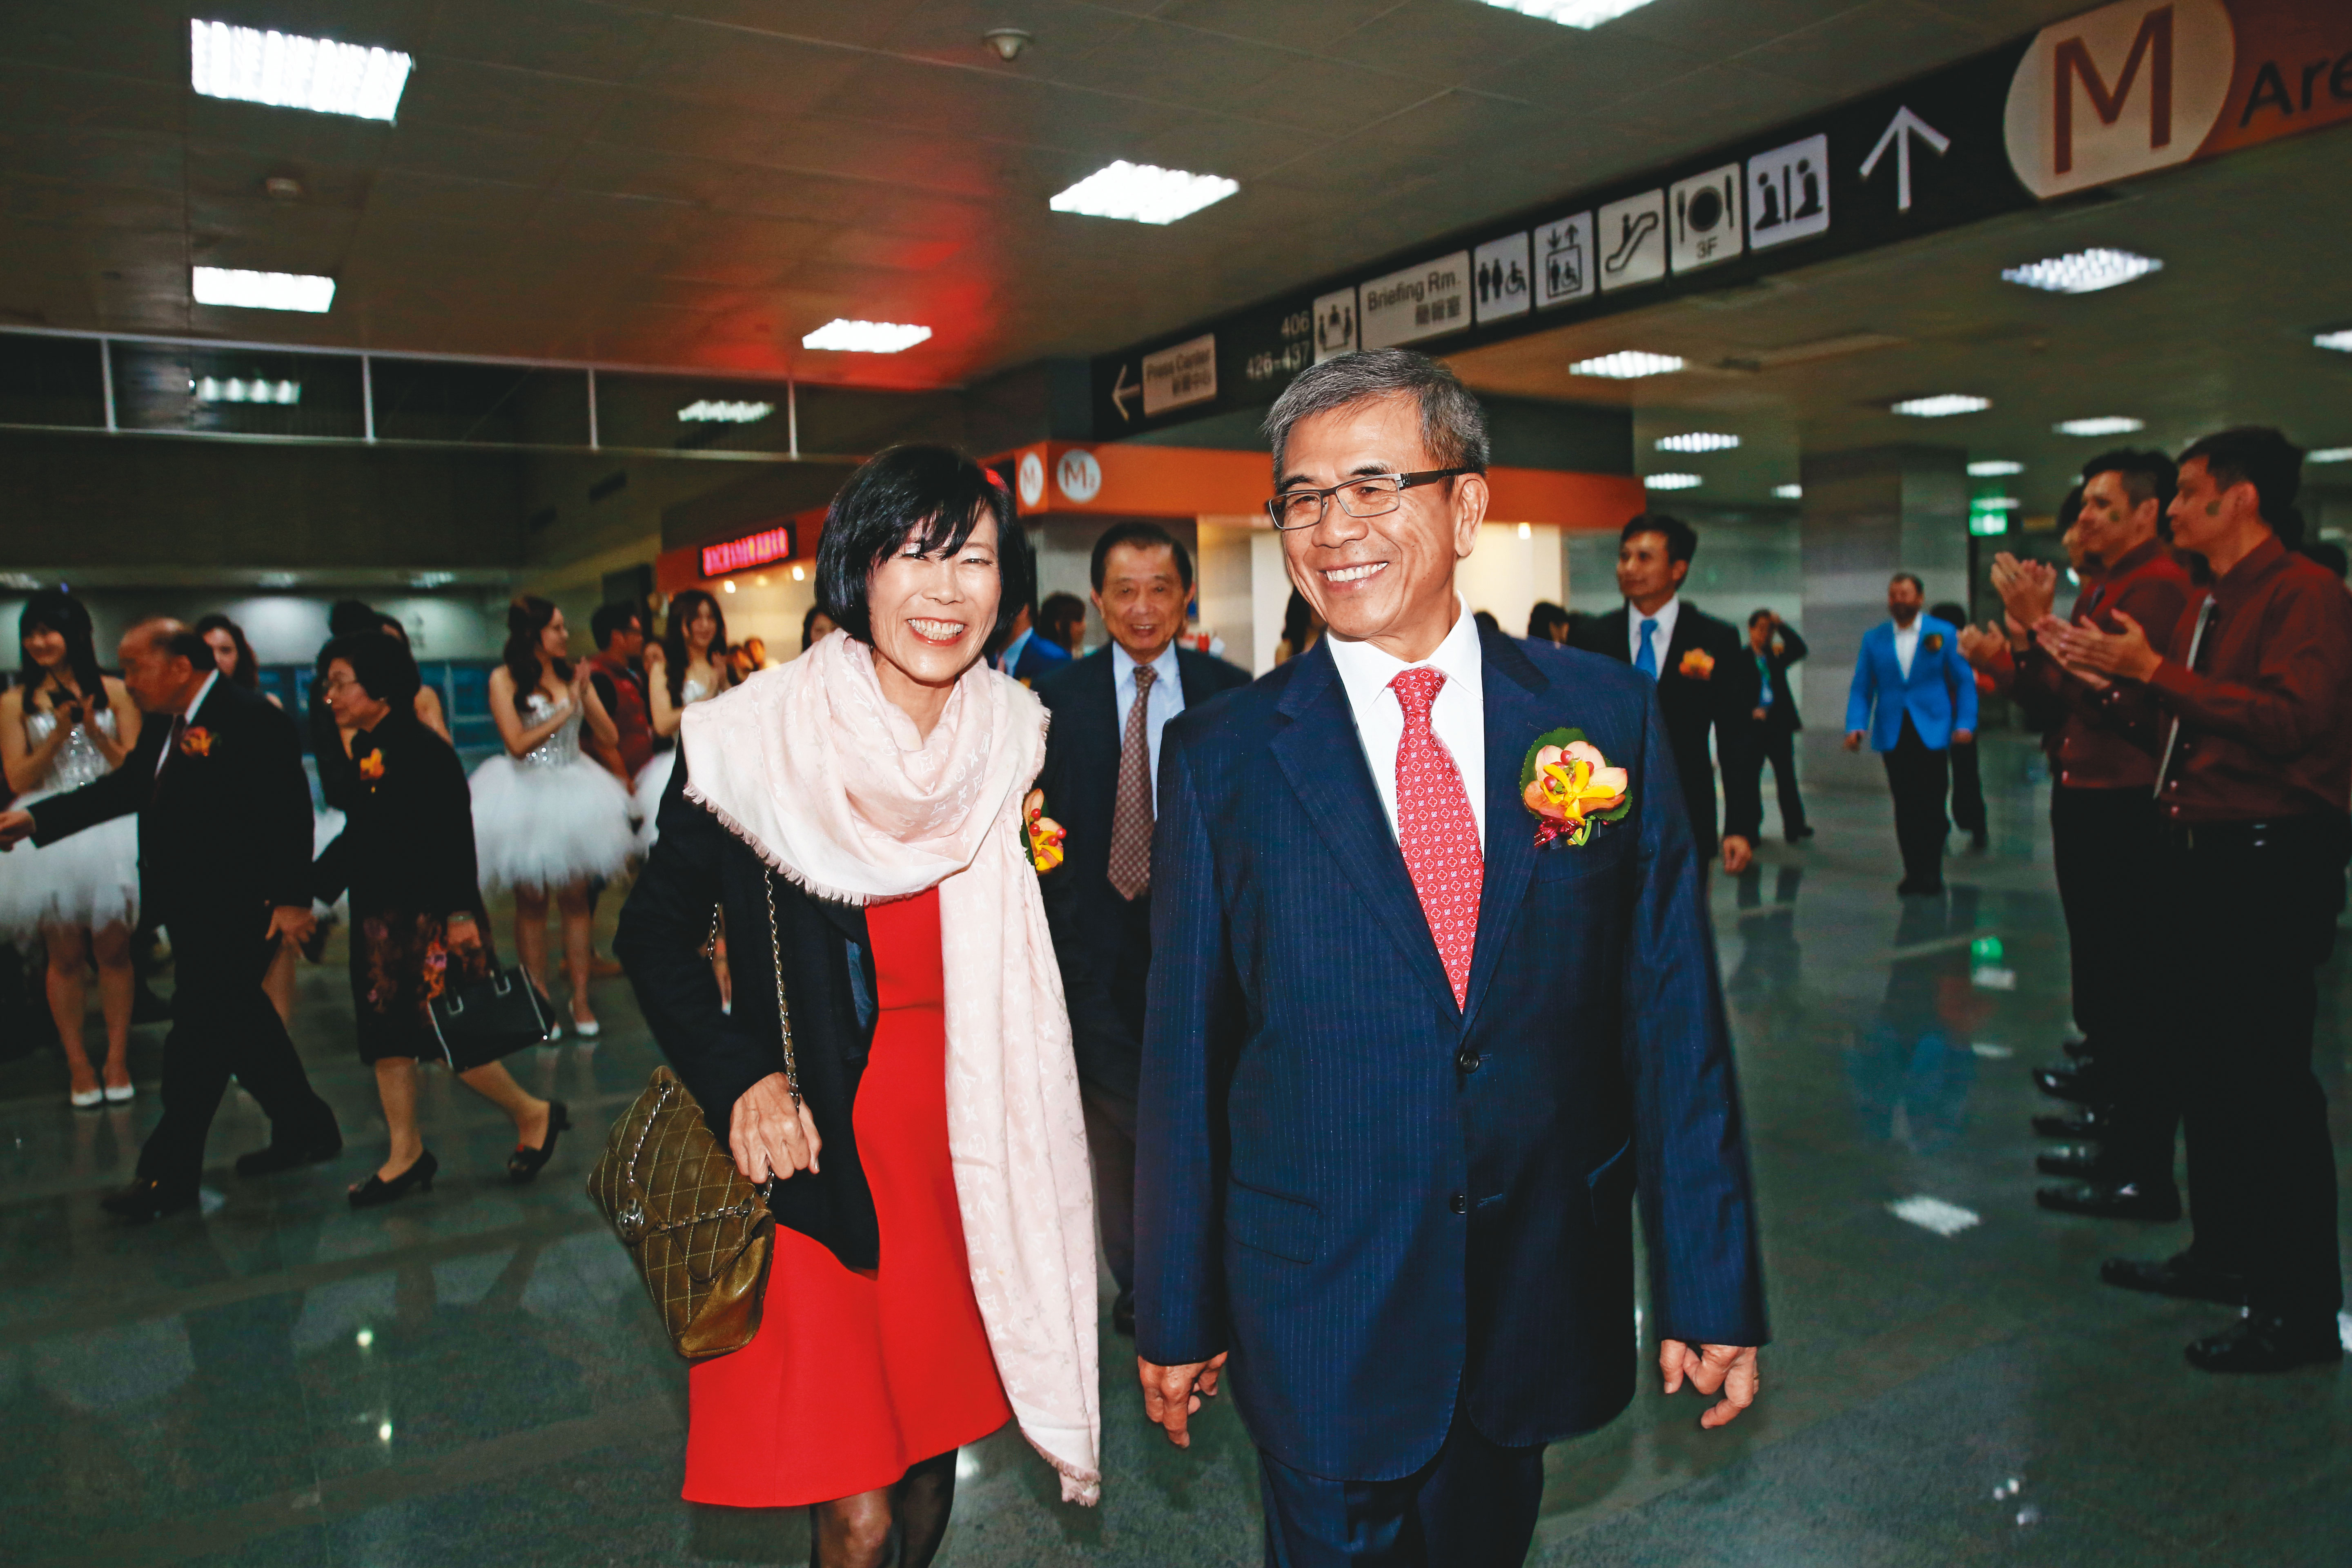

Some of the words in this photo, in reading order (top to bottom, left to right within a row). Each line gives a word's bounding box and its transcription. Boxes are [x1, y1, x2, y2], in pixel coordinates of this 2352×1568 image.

[2054, 3, 2173, 176] M
[1696, 236, 1718, 258] 3F
[1368, 281, 1425, 312] Briefing
